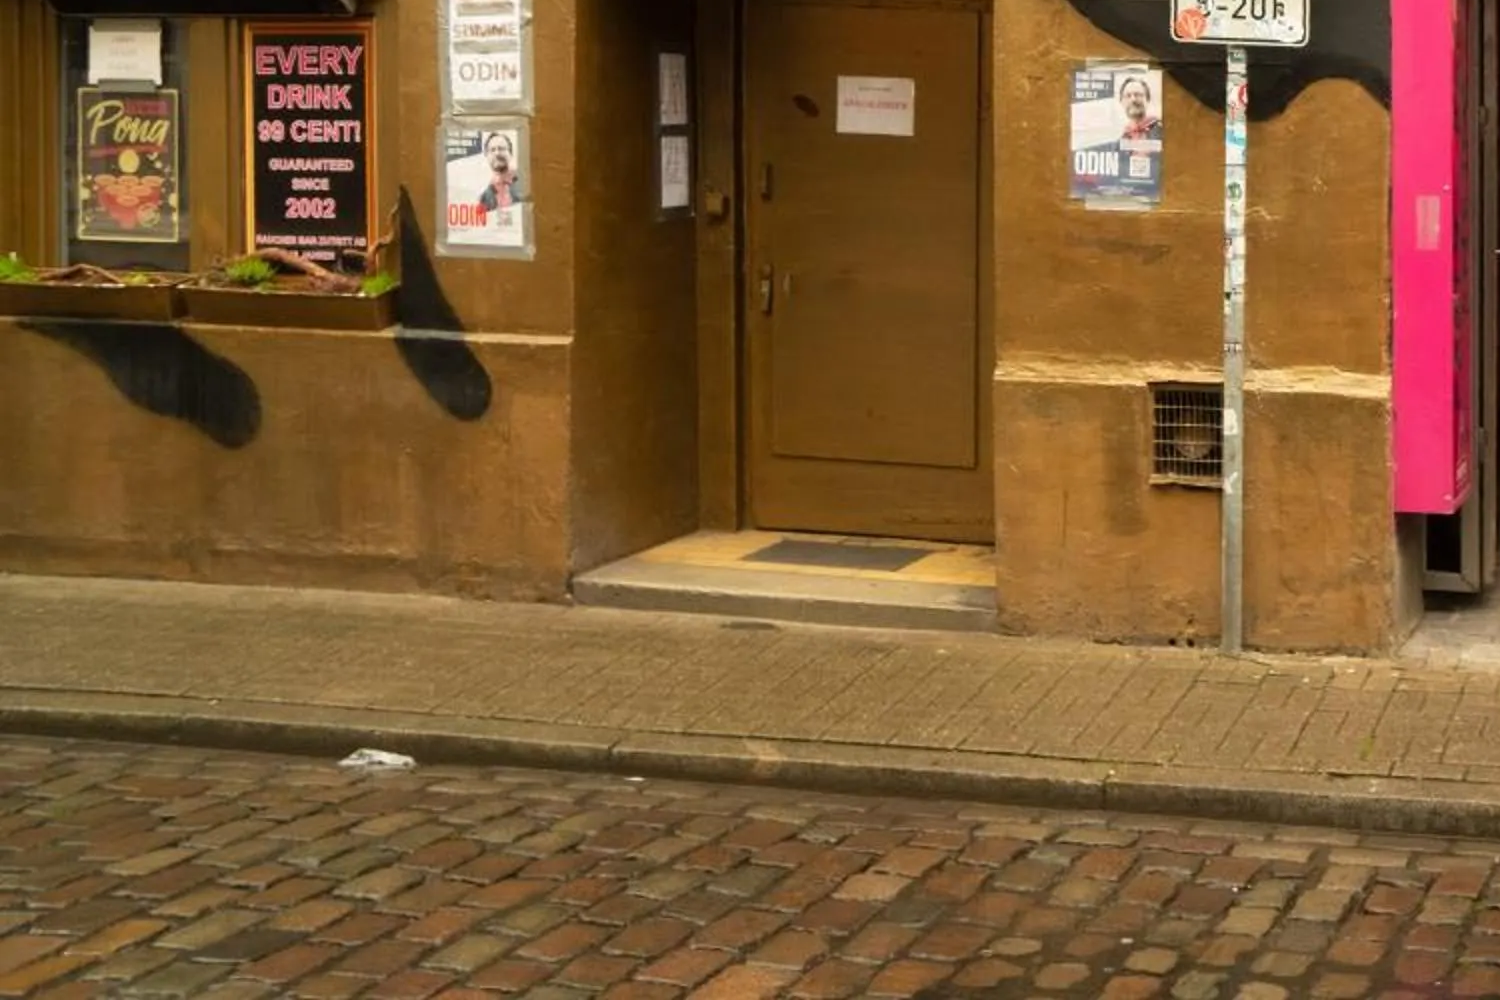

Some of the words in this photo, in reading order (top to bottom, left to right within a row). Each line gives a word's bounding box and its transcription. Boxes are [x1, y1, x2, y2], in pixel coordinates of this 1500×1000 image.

[255, 45, 363, 75] EVERY
[459, 62, 517, 82] ODIN
[267, 84, 353, 110] DRINK
[86, 100, 170, 146] Pong
[257, 119, 285, 143] 99
[290, 119, 361, 143] CENT!
[268, 158, 355, 172] GUARANTEED
[1074, 152, 1120, 176] ODIN
[291, 178, 330, 191] SINCE
[285, 197, 336, 219] 2002
[448, 203, 487, 227] ODIN
